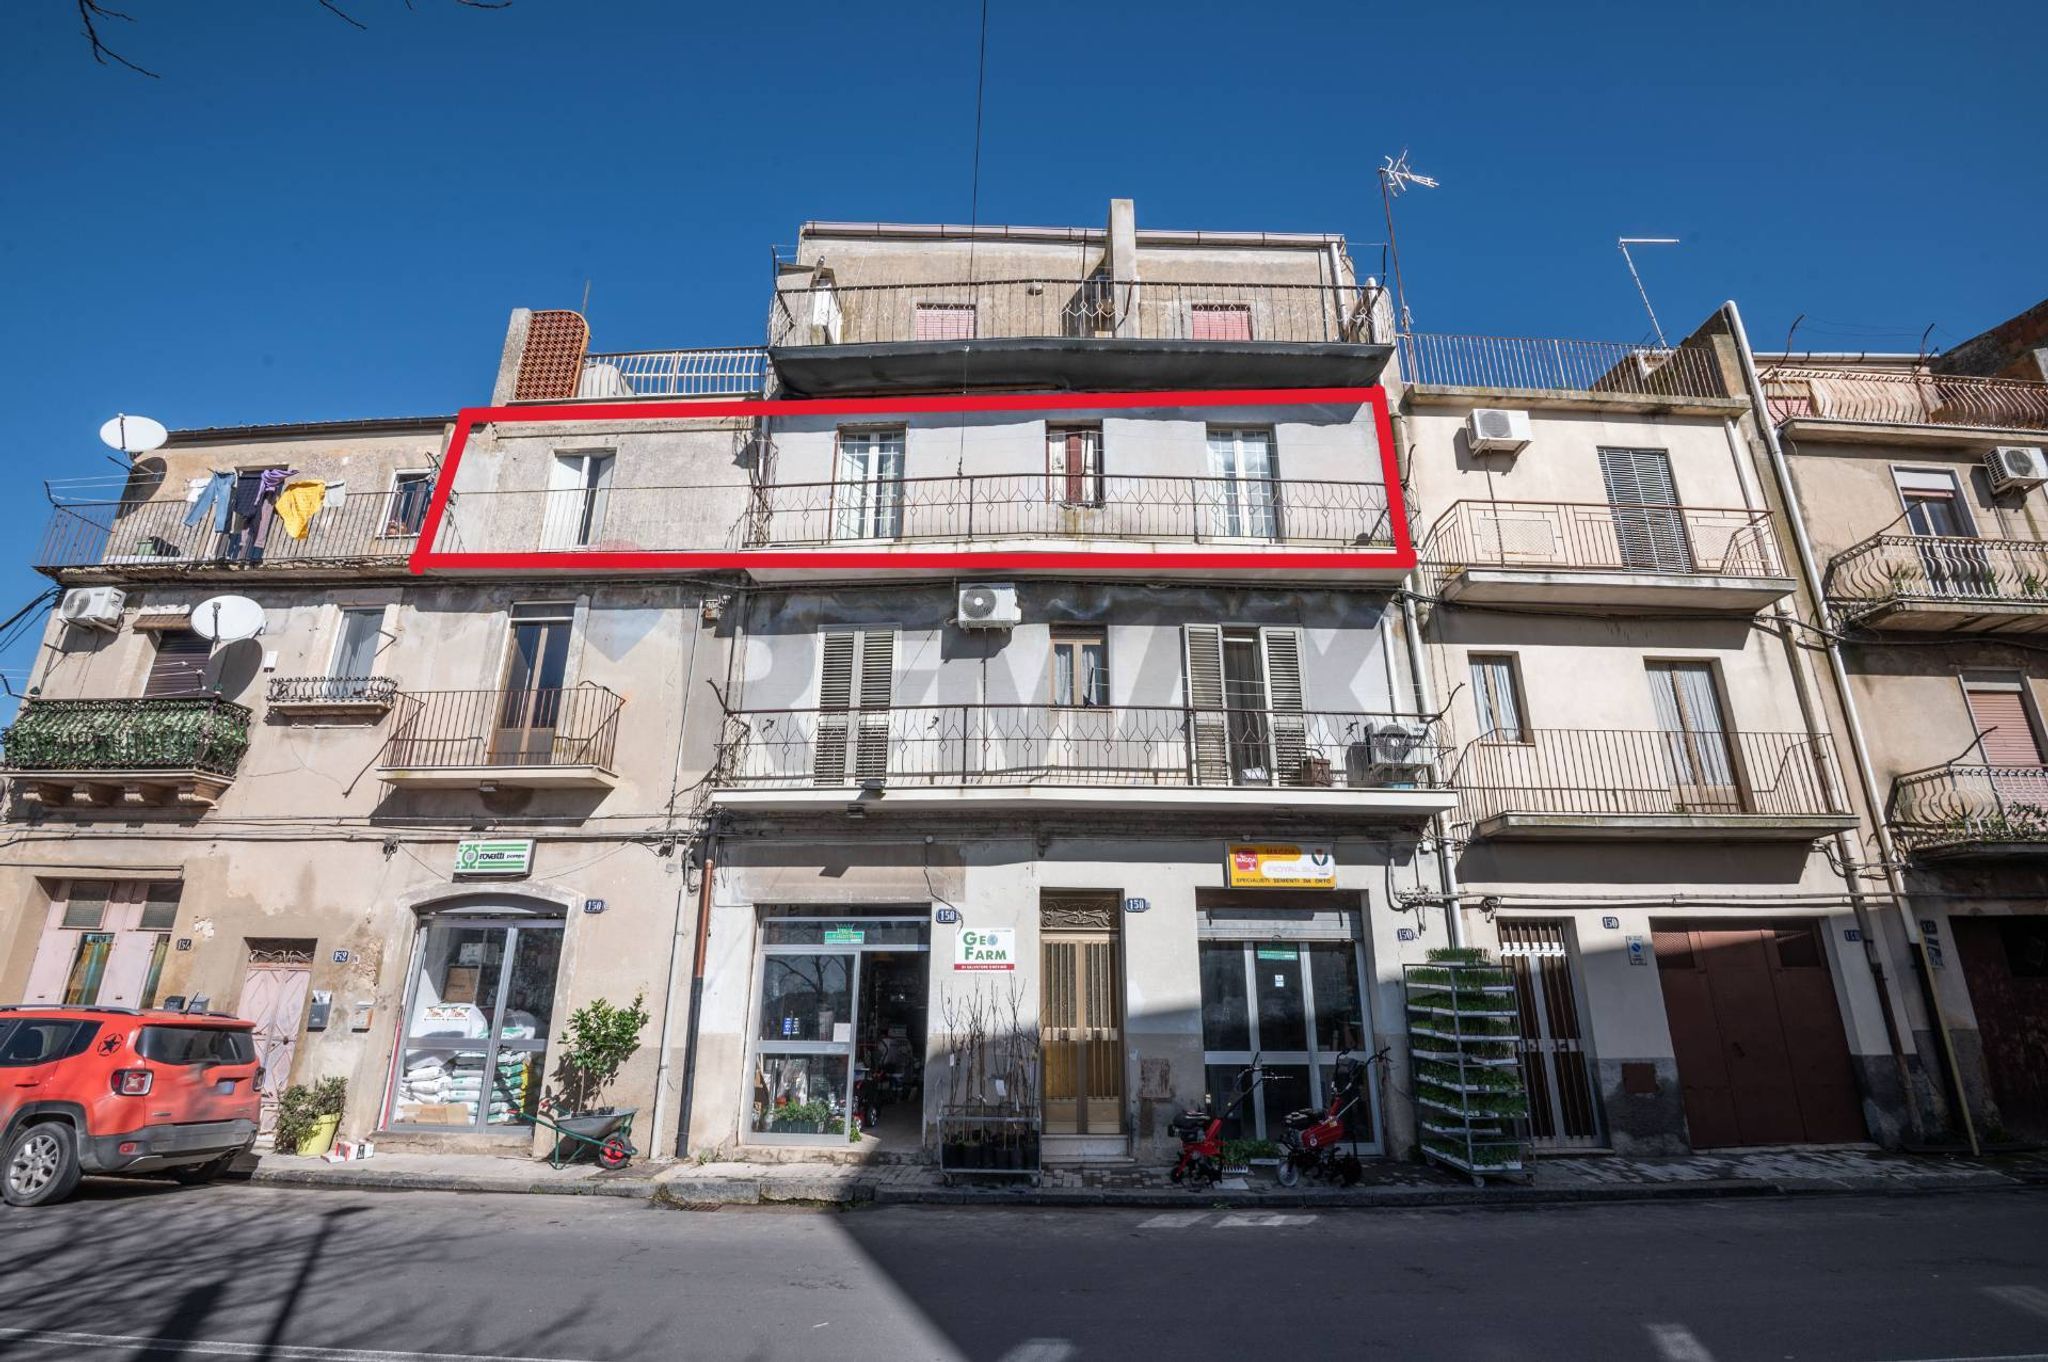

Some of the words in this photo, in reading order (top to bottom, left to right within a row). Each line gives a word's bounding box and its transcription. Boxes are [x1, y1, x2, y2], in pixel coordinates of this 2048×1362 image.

[1129, 899, 1144, 910] 150
[940, 910, 955, 921] 150
[964, 946, 1007, 961] FARM
